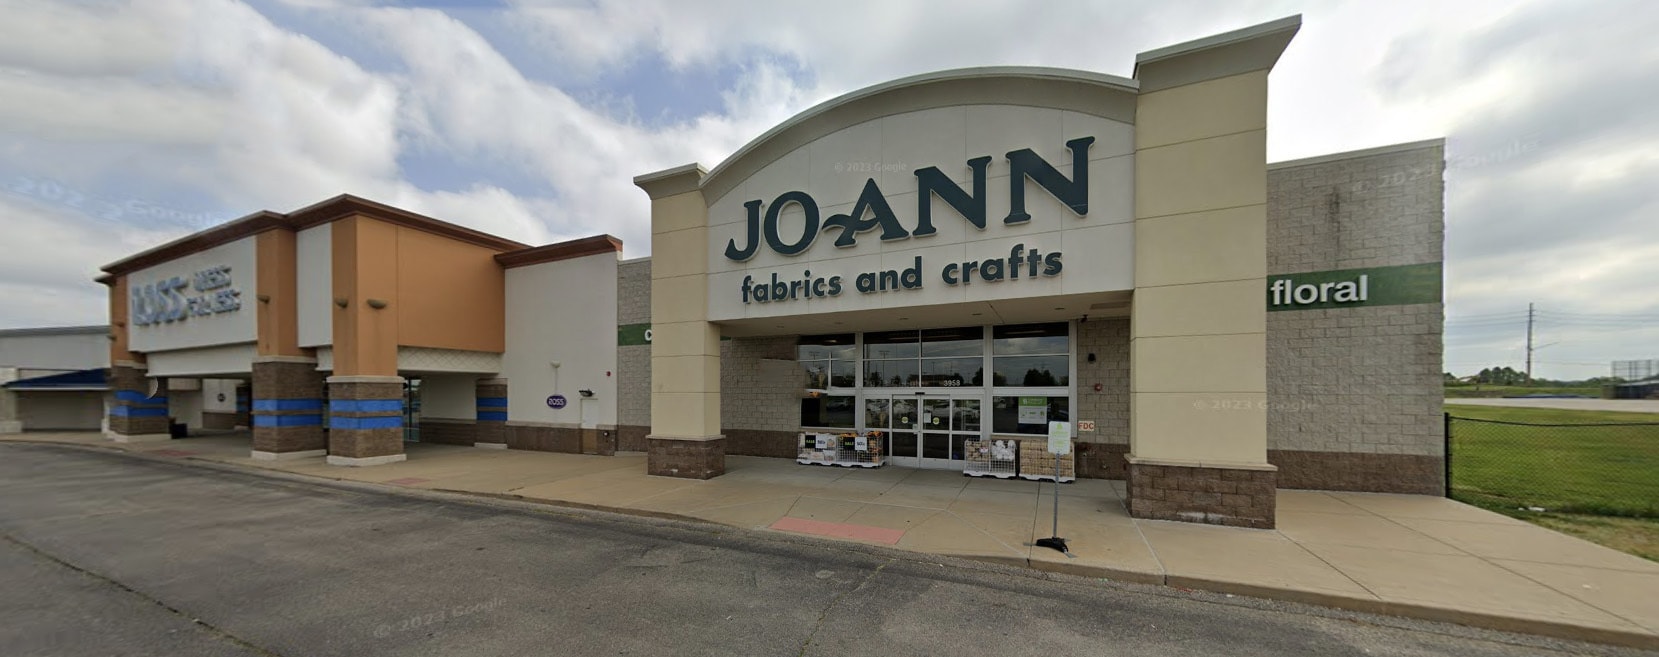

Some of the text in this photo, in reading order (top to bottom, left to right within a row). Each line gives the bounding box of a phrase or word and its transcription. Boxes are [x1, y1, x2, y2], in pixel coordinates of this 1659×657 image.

[741, 243, 1063, 304] fabrics and crafts
[1270, 275, 1369, 305] floral
[1078, 422, 1095, 430] FDC
